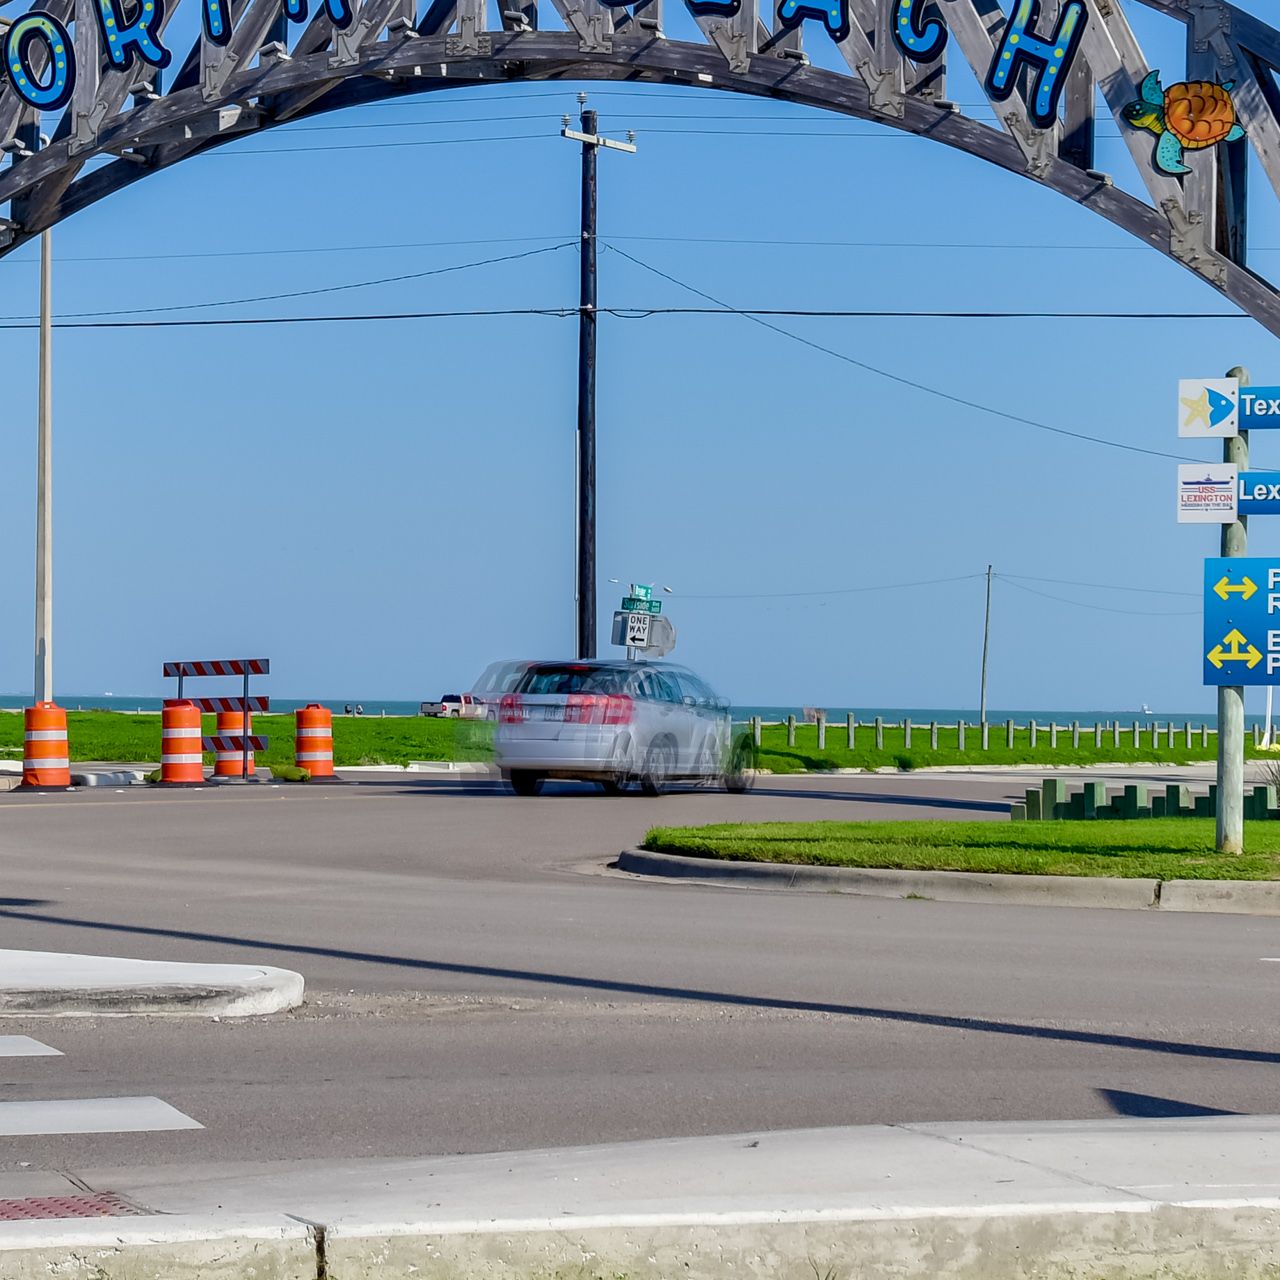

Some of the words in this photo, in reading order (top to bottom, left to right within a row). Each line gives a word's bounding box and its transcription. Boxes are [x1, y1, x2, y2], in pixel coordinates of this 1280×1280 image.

[1181, 494, 1233, 502] LEXINGTON
[631, 616, 647, 625] ONE
[629, 625, 647, 634] WAY
